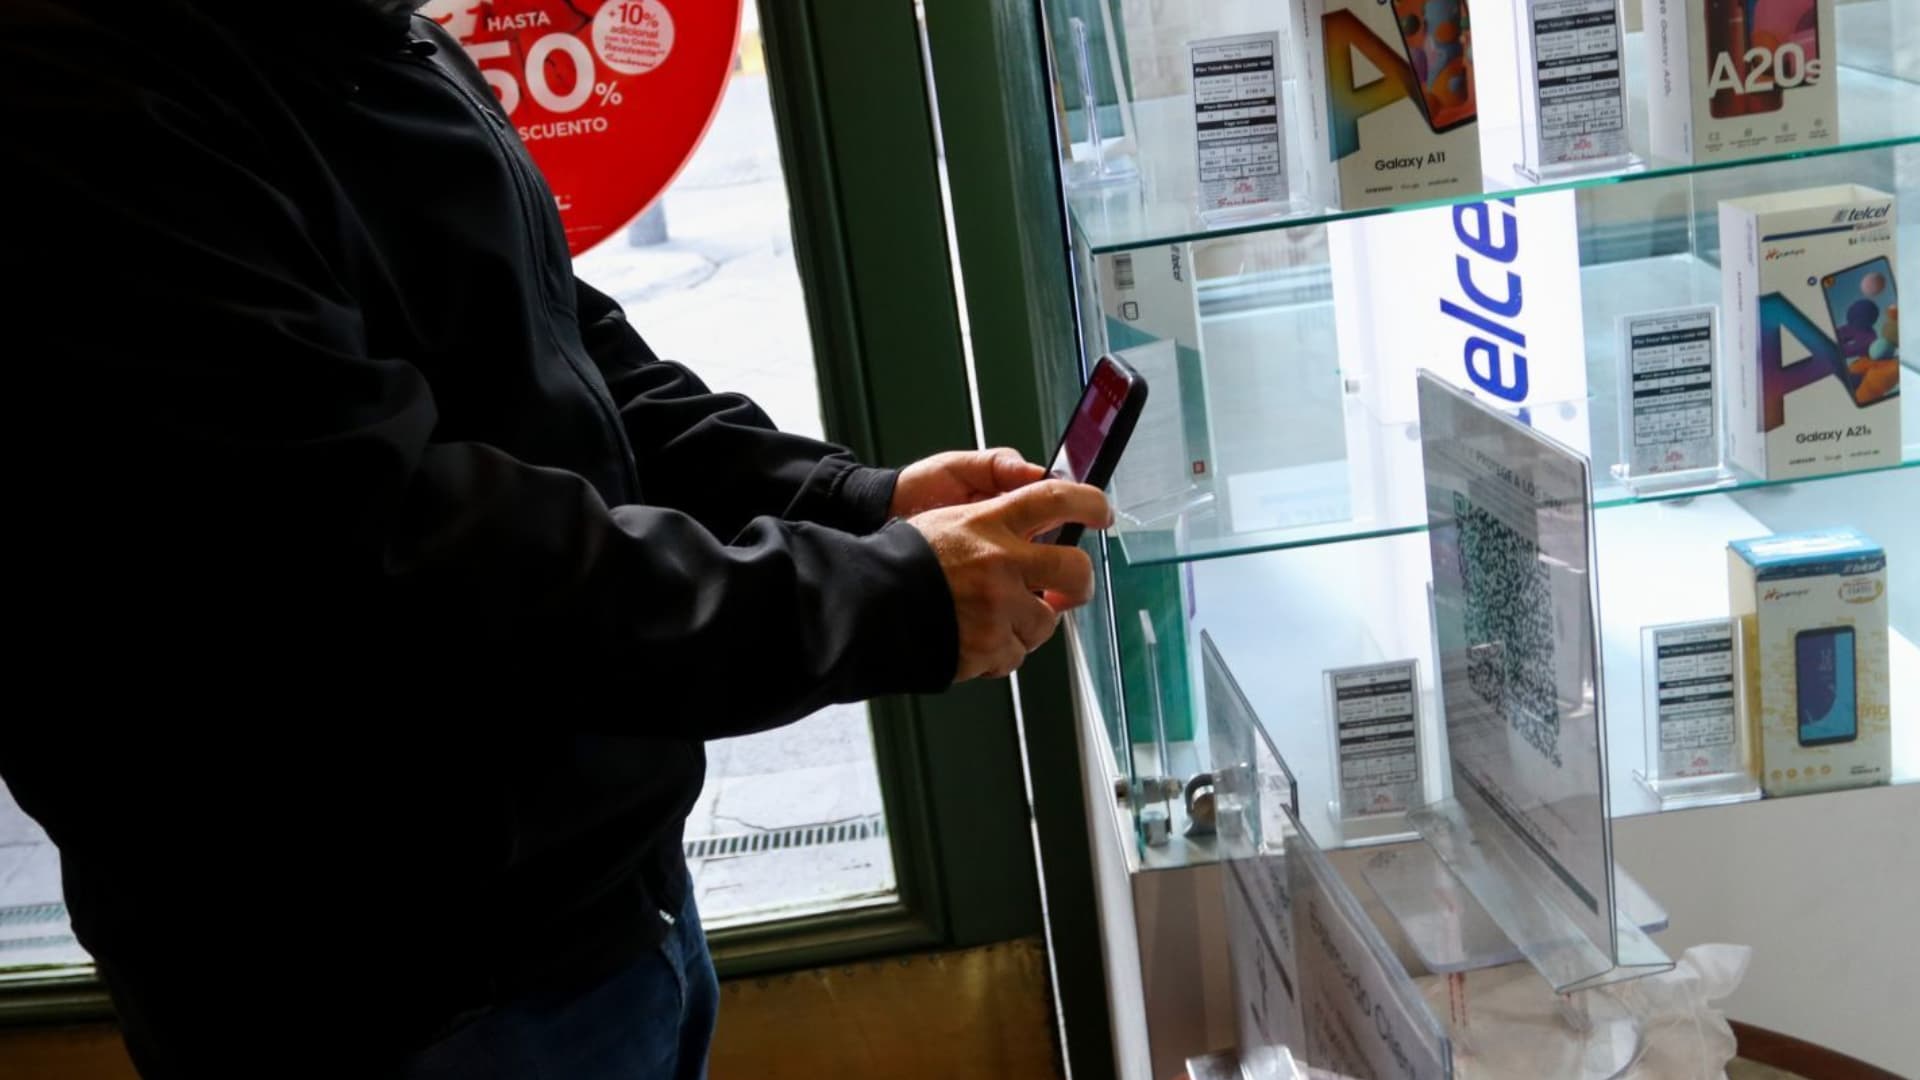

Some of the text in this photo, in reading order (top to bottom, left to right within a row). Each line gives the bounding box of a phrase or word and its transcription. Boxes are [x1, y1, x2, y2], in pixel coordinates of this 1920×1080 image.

[486, 10, 551, 32] HASTA
[1706, 42, 1823, 98] A20s
[517, 117, 608, 141] SCUENTO
[1375, 150, 1447, 171] Galaxy A11
[1848, 203, 1892, 222] telcel
[1440, 195, 1532, 427] elce
[1796, 430, 1842, 444] Galaxy
